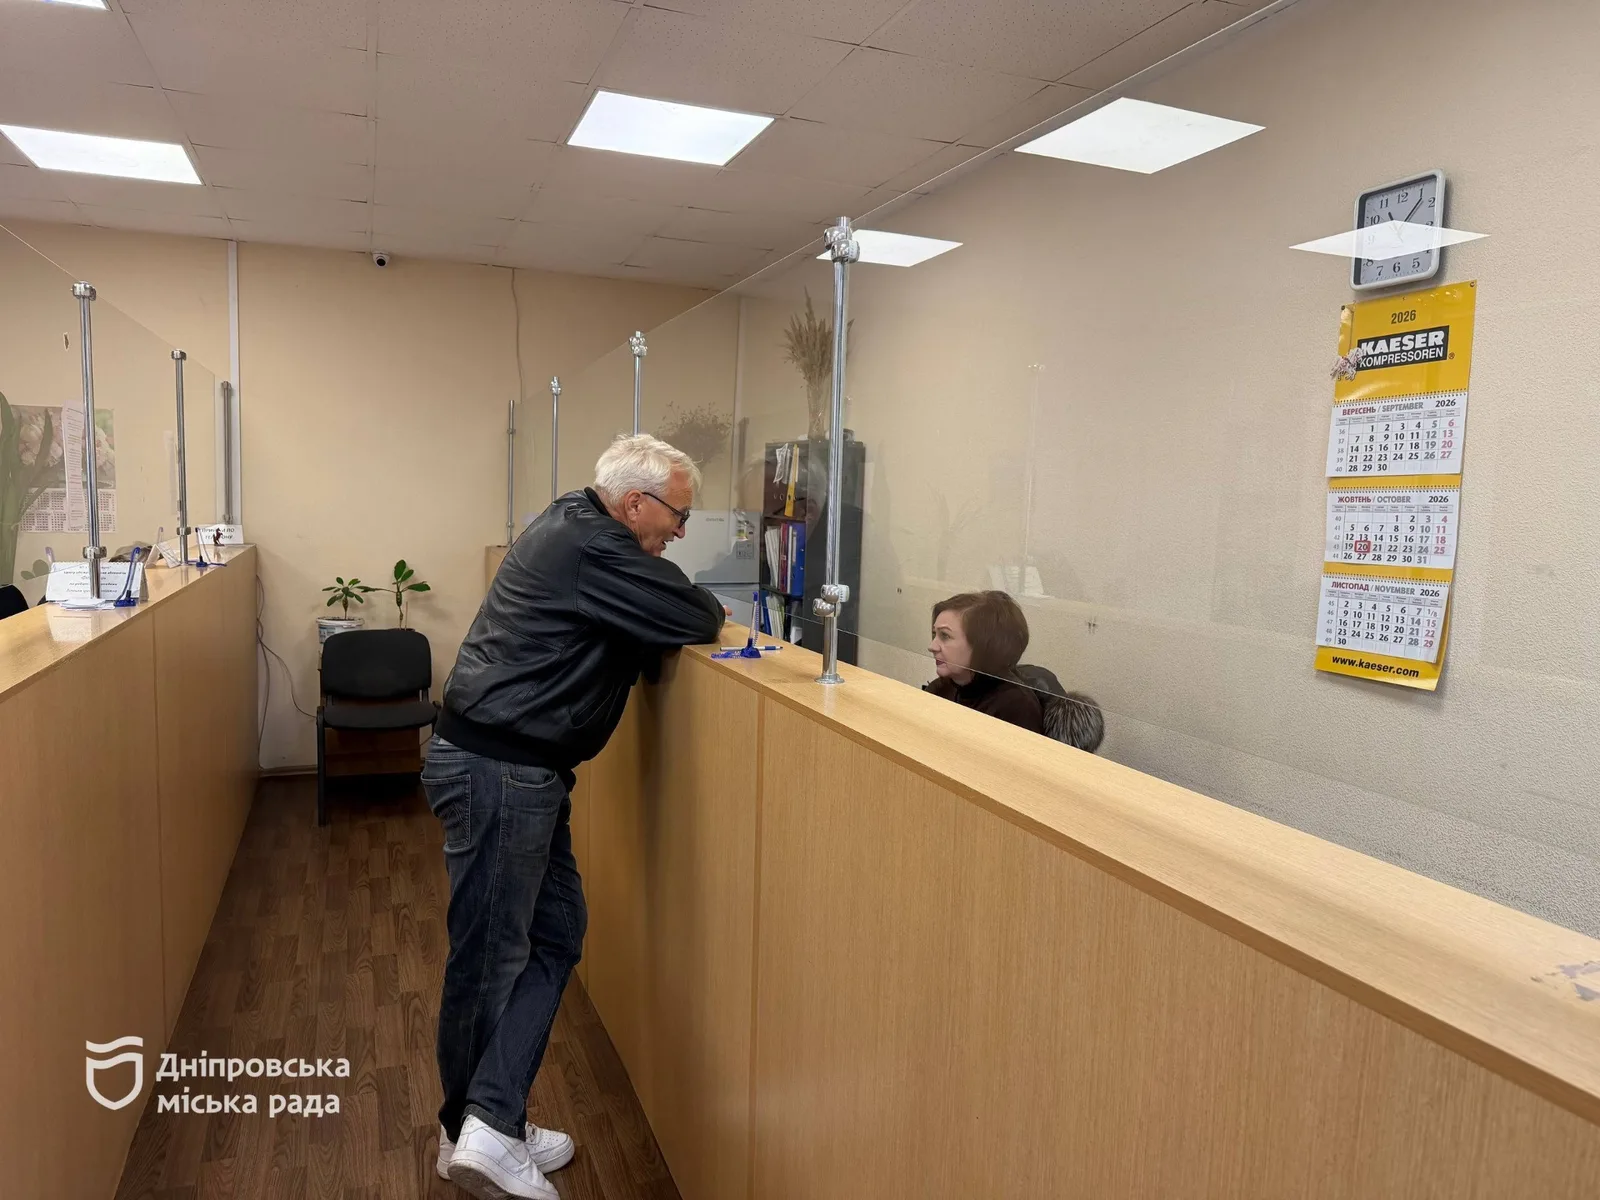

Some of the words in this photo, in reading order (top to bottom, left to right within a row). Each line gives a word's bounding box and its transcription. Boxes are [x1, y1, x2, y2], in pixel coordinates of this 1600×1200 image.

[1419, 188, 1423, 197] 1
[1380, 198, 1389, 208] 11
[1397, 192, 1408, 204] 12
[1428, 197, 1435, 208] 2
[1370, 215, 1380, 225] 10
[1393, 262, 1400, 273] 6
[1412, 257, 1420, 268] 5
[1377, 266, 1383, 276] 7
[1391, 310, 1416, 324] 2026
[1361, 330, 1444, 353] KAESER
[1360, 347, 1444, 368] KOMPRESSOREN
[1342, 407, 1376, 415] ВЕРЕСЕНЬ
[1382, 402, 1423, 412] SEPTEMBER
[1435, 399, 1456, 408] 2026
[1436, 536, 1446, 544] 18
[1418, 546, 1428, 554] 24
[1417, 556, 1427, 564] 31
[1332, 582, 1369, 591] ЛИСТОПАД
[1374, 585, 1415, 595] NOVEMBER
[1411, 617, 1421, 626] 14
[1426, 619, 1436, 627] 15
[1409, 628, 1420, 636] 21
[1408, 638, 1419, 646] 28
[1332, 656, 1419, 678] www.kaeser.com
